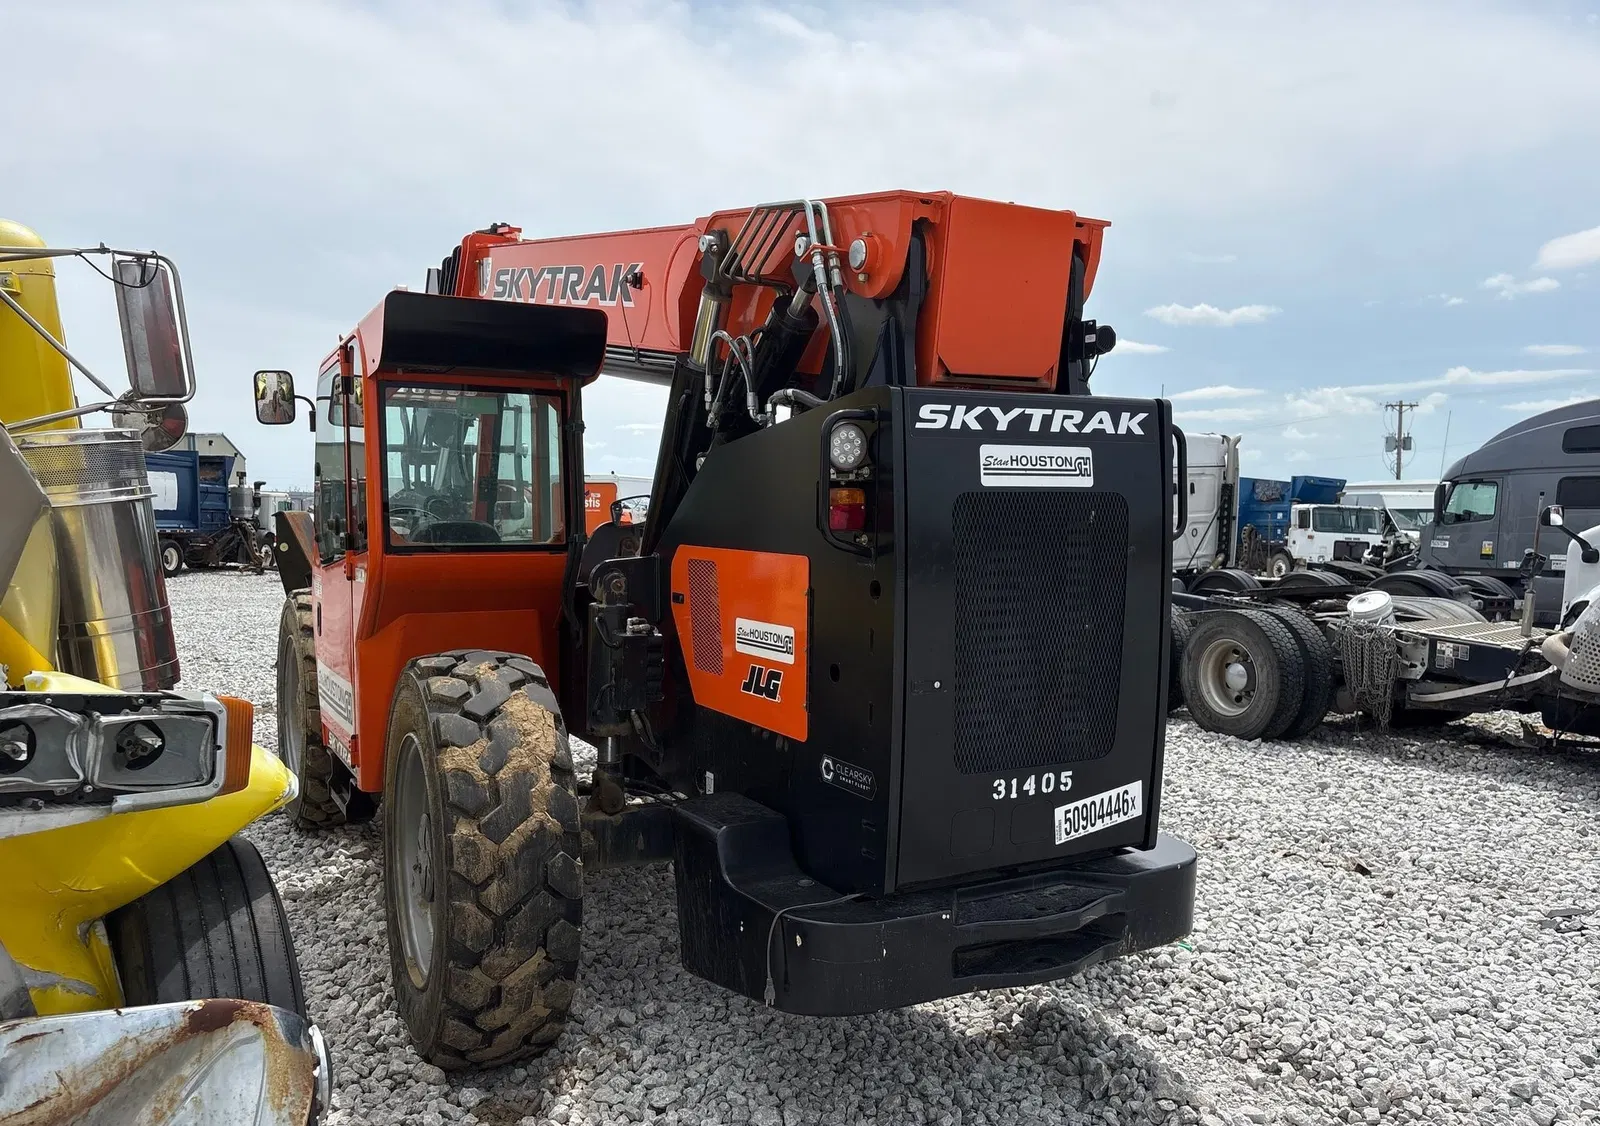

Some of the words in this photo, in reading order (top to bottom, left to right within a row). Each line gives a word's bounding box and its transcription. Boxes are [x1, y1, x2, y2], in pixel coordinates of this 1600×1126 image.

[492, 262, 643, 306] SKYTRAK
[915, 403, 1149, 435] SKYTRAK
[982, 455, 1009, 466] Stan
[1010, 455, 1073, 468] HOUSTON
[749, 628, 783, 645] HOUSTON
[741, 664, 783, 702] JLG
[835, 763, 872, 785] CLEARSKY
[992, 770, 1073, 800] 31405
